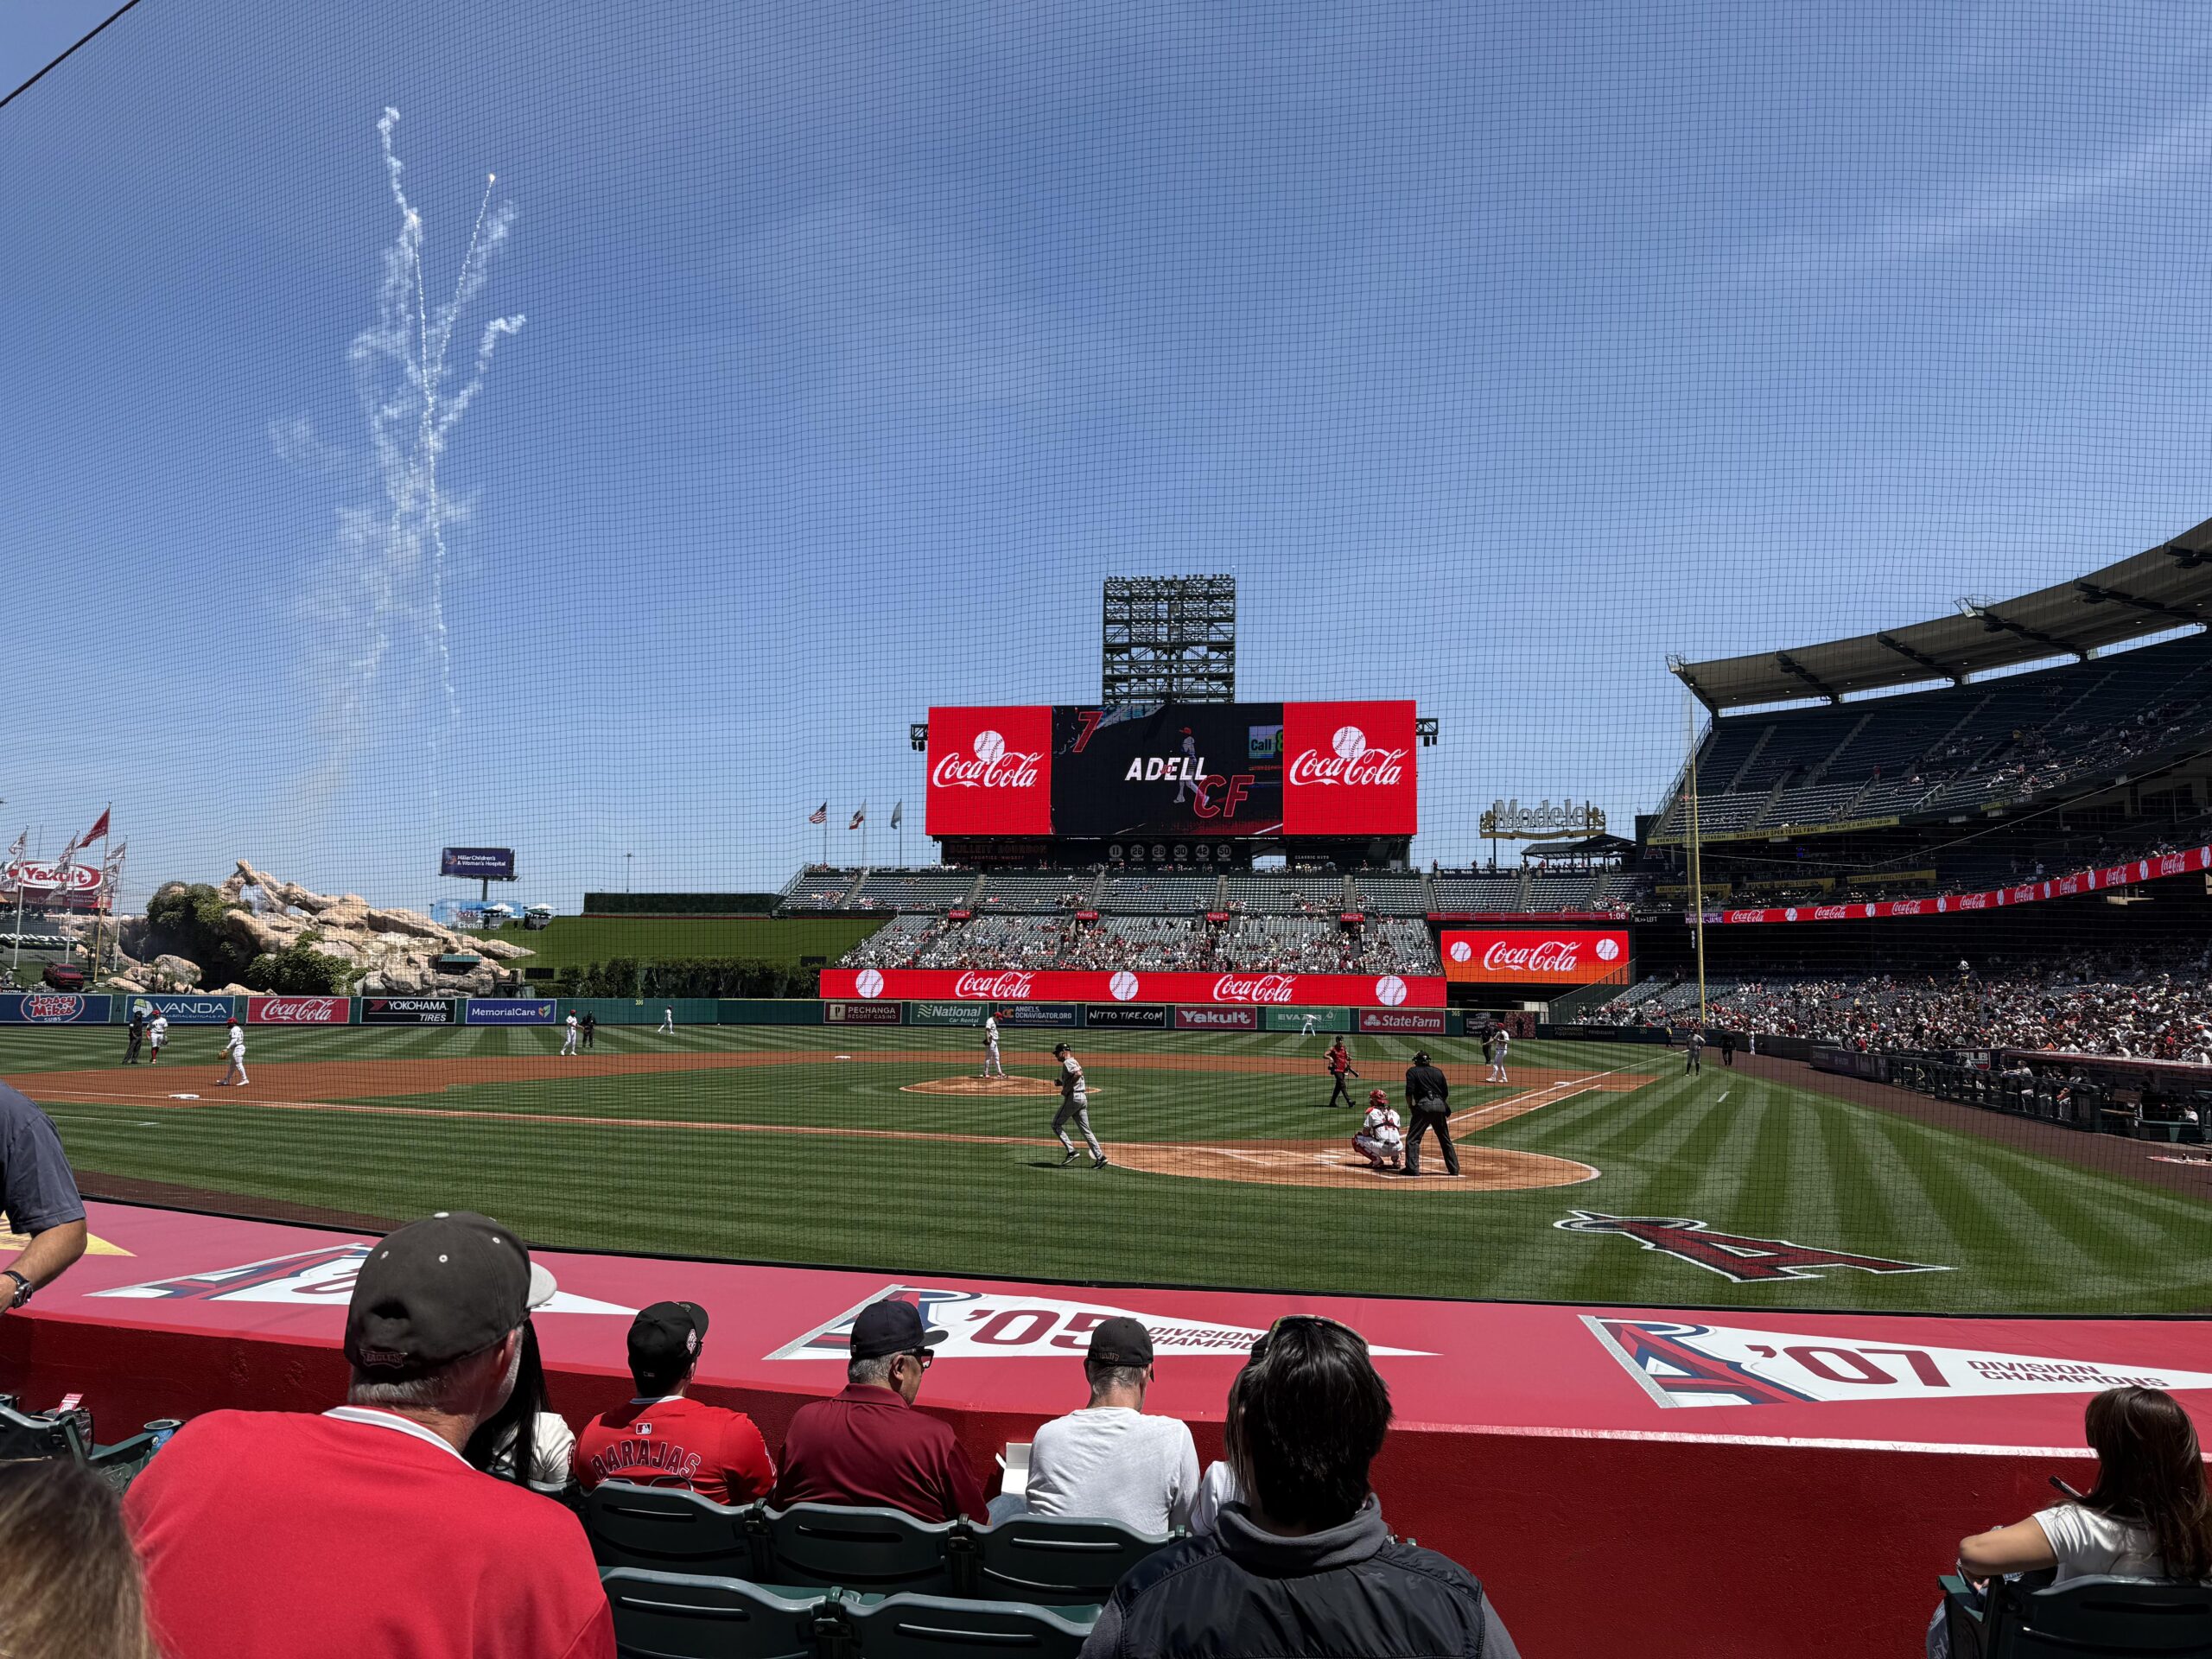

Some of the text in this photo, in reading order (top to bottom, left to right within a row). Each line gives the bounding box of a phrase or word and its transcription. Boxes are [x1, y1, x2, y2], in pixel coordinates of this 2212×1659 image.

[1072, 711, 1103, 753] 7
[1251, 739, 1271, 751] Call
[933, 753, 1045, 787] Coca-Cola
[1125, 757, 1208, 781] ADELL
[1289, 749, 1409, 785] Coca-Cola
[1193, 775, 1255, 818] CF
[1495, 798, 1587, 828] Modelo
[1484, 941, 1582, 971] Coca-Cola
[955, 971, 1036, 998] Coca-Cola
[1213, 975, 1297, 1001] Coca-Cola
[29, 995, 76, 1007] Jersey
[156, 1002, 226, 1014] VANDA
[261, 999, 336, 1021] Coca-Cola
[420, 1014, 447, 1022] TIRES
[472, 1007, 536, 1016] MemorialCare
[932, 1006, 982, 1017] National
[1089, 1009, 1163, 1021] NITTO TIRE.COM
[1181, 1010, 1252, 1024] Yakult
[1148, 1326, 1263, 1341] DIVISION
[365, 1353, 401, 1363] EAGLES
[1746, 1344, 1951, 1388] '07
[1967, 1360, 2101, 1375] DIVISION
[1980, 1370, 2170, 1388] CHAMPIONS
[591, 1439, 702, 1480] BARAJAS
